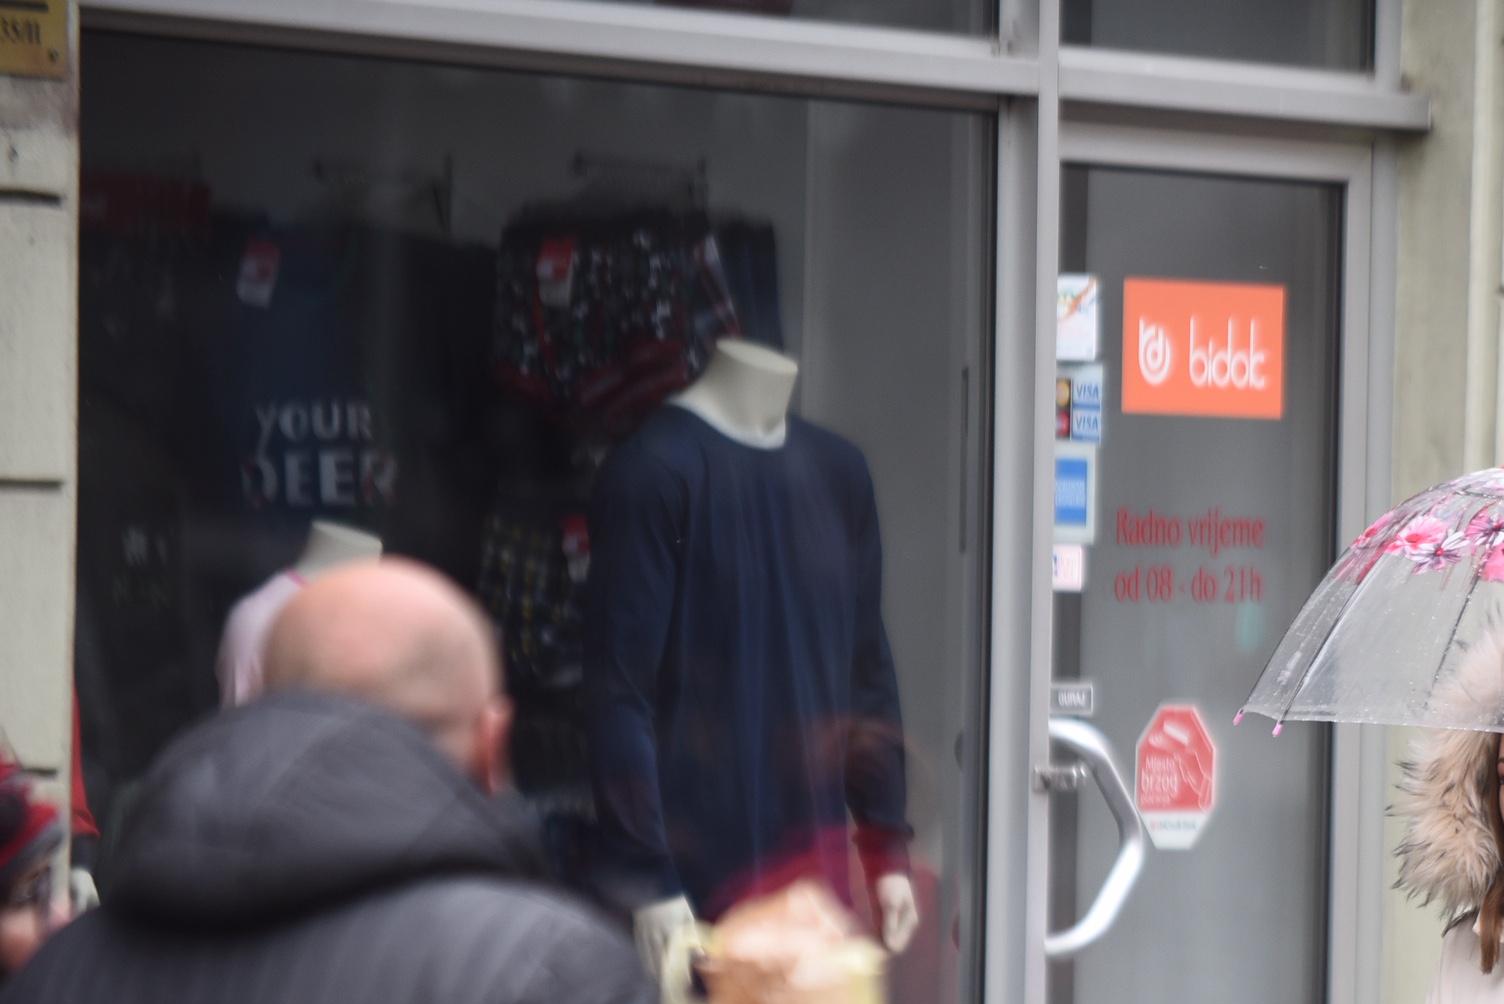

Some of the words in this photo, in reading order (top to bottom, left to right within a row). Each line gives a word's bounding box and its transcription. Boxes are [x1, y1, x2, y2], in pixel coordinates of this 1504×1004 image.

[1076, 383, 1098, 398] VISA
[252, 401, 374, 443] YOUR
[1075, 417, 1098, 431] VISA
[240, 451, 398, 505] DEER
[1116, 507, 1182, 546] Radno
[1188, 506, 1265, 558] vrijeme
[1115, 566, 1140, 603] od
[1147, 565, 1173, 603] 08
[1191, 567, 1217, 603] do
[1224, 566, 1263, 605] 21h
